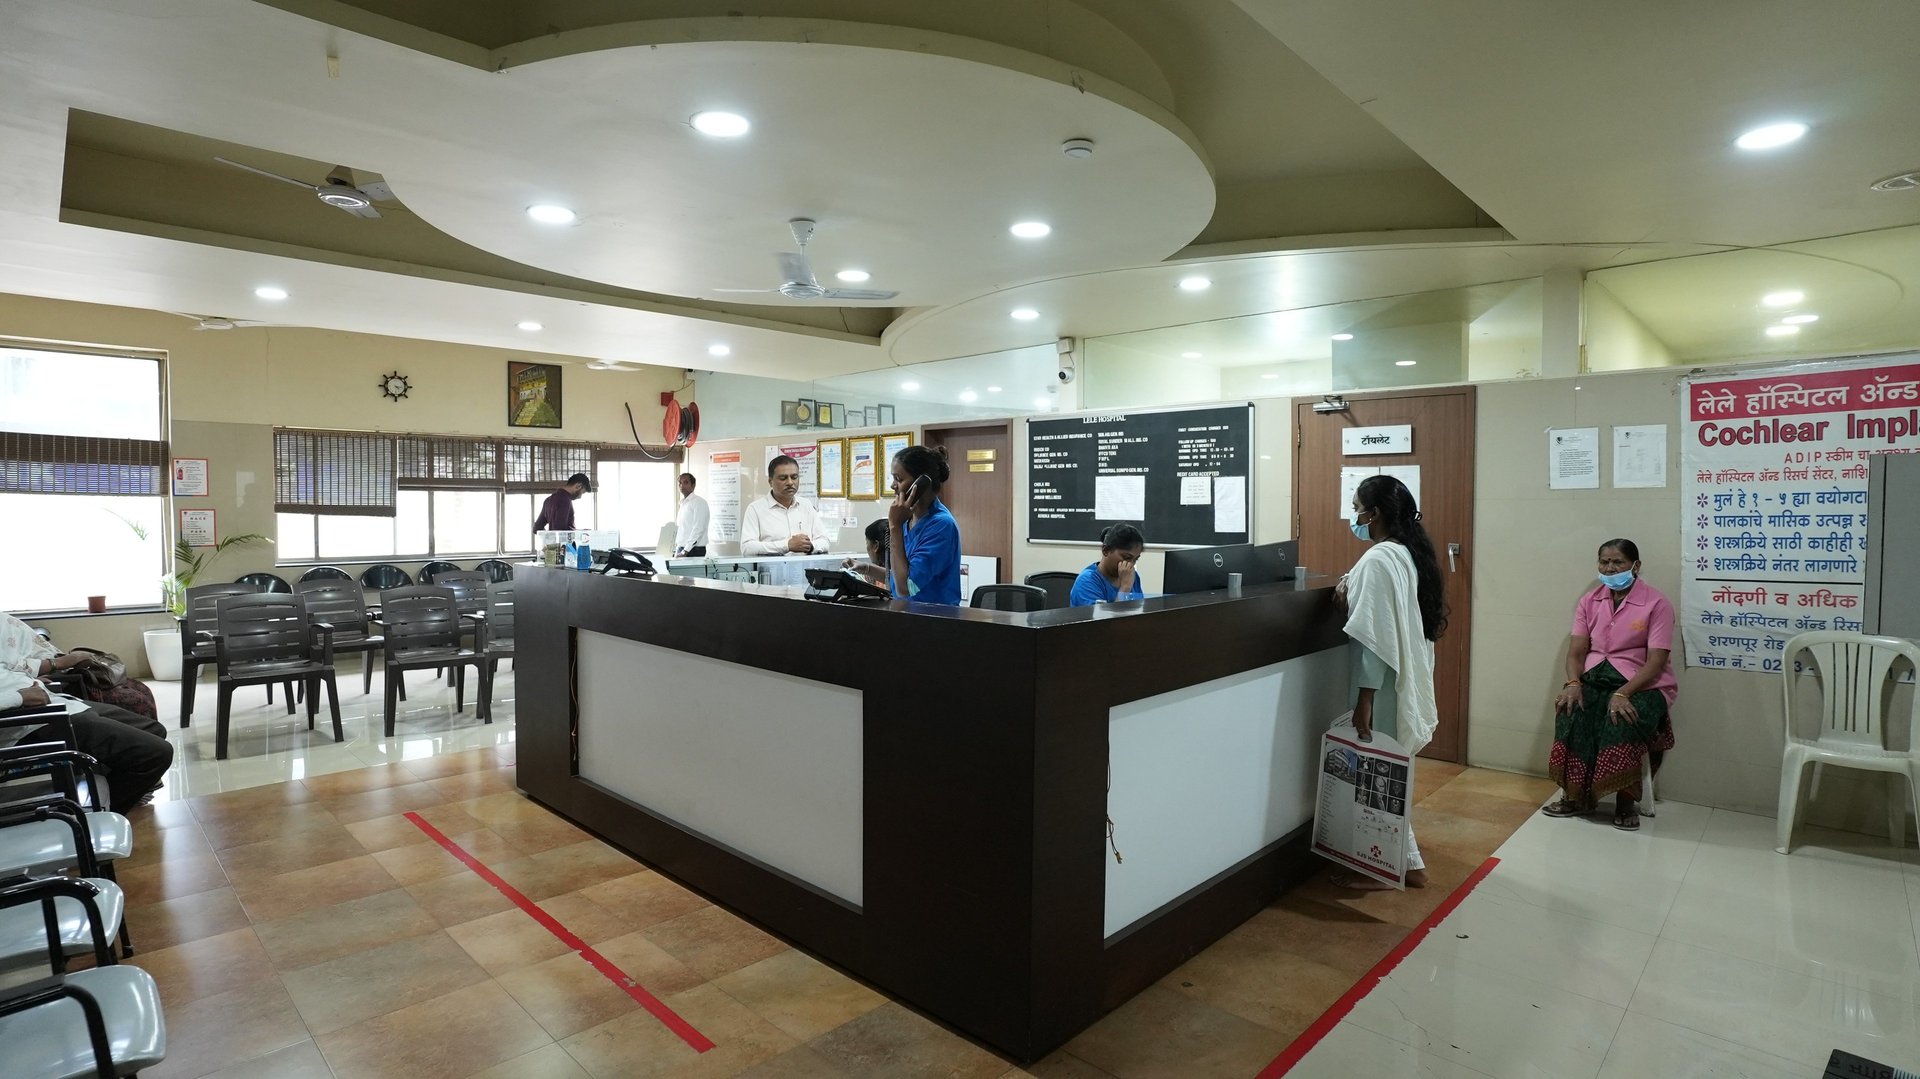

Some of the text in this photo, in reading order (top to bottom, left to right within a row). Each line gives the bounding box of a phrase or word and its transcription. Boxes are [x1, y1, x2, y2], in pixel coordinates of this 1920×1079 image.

[1697, 388, 1737, 414] लेले
[1746, 383, 1850, 414] हॉस्पिटल
[1698, 409, 1920, 447] Cochlear Impl
[1361, 434, 1390, 445] टॉयलेट
[1825, 447, 1854, 461] स्कीम
[1697, 470, 1712, 483] लेले
[1716, 468, 1755, 484] हॉस्पिटल
[1783, 466, 1809, 480] रिसर्च
[1714, 489, 1733, 511] मुलं
[1738, 489, 1746, 508] हे
[1714, 510, 1762, 528] पालकांचे
[1768, 509, 1811, 528] मासिक
[1816, 514, 1854, 529] उत्पन्न
[1714, 531, 1767, 550] शस्त्रक्रिये
[1772, 532, 1802, 550] साठी
[1808, 531, 1853, 552] काहीही
[1714, 553, 1857, 573] शस्त्रक्रिये नंतर लागणारे
[1712, 586, 1858, 608] नोंदणी व अधिक
[1701, 611, 1724, 625] लेले
[1730, 612, 1788, 628] हॉस्पिटल
[1834, 616, 1863, 632] रिस
[1709, 635, 1785, 652] शरणपूर रोड
[1698, 653, 1727, 667] फोन
[1368, 856, 1396, 870] HOSPITAL
